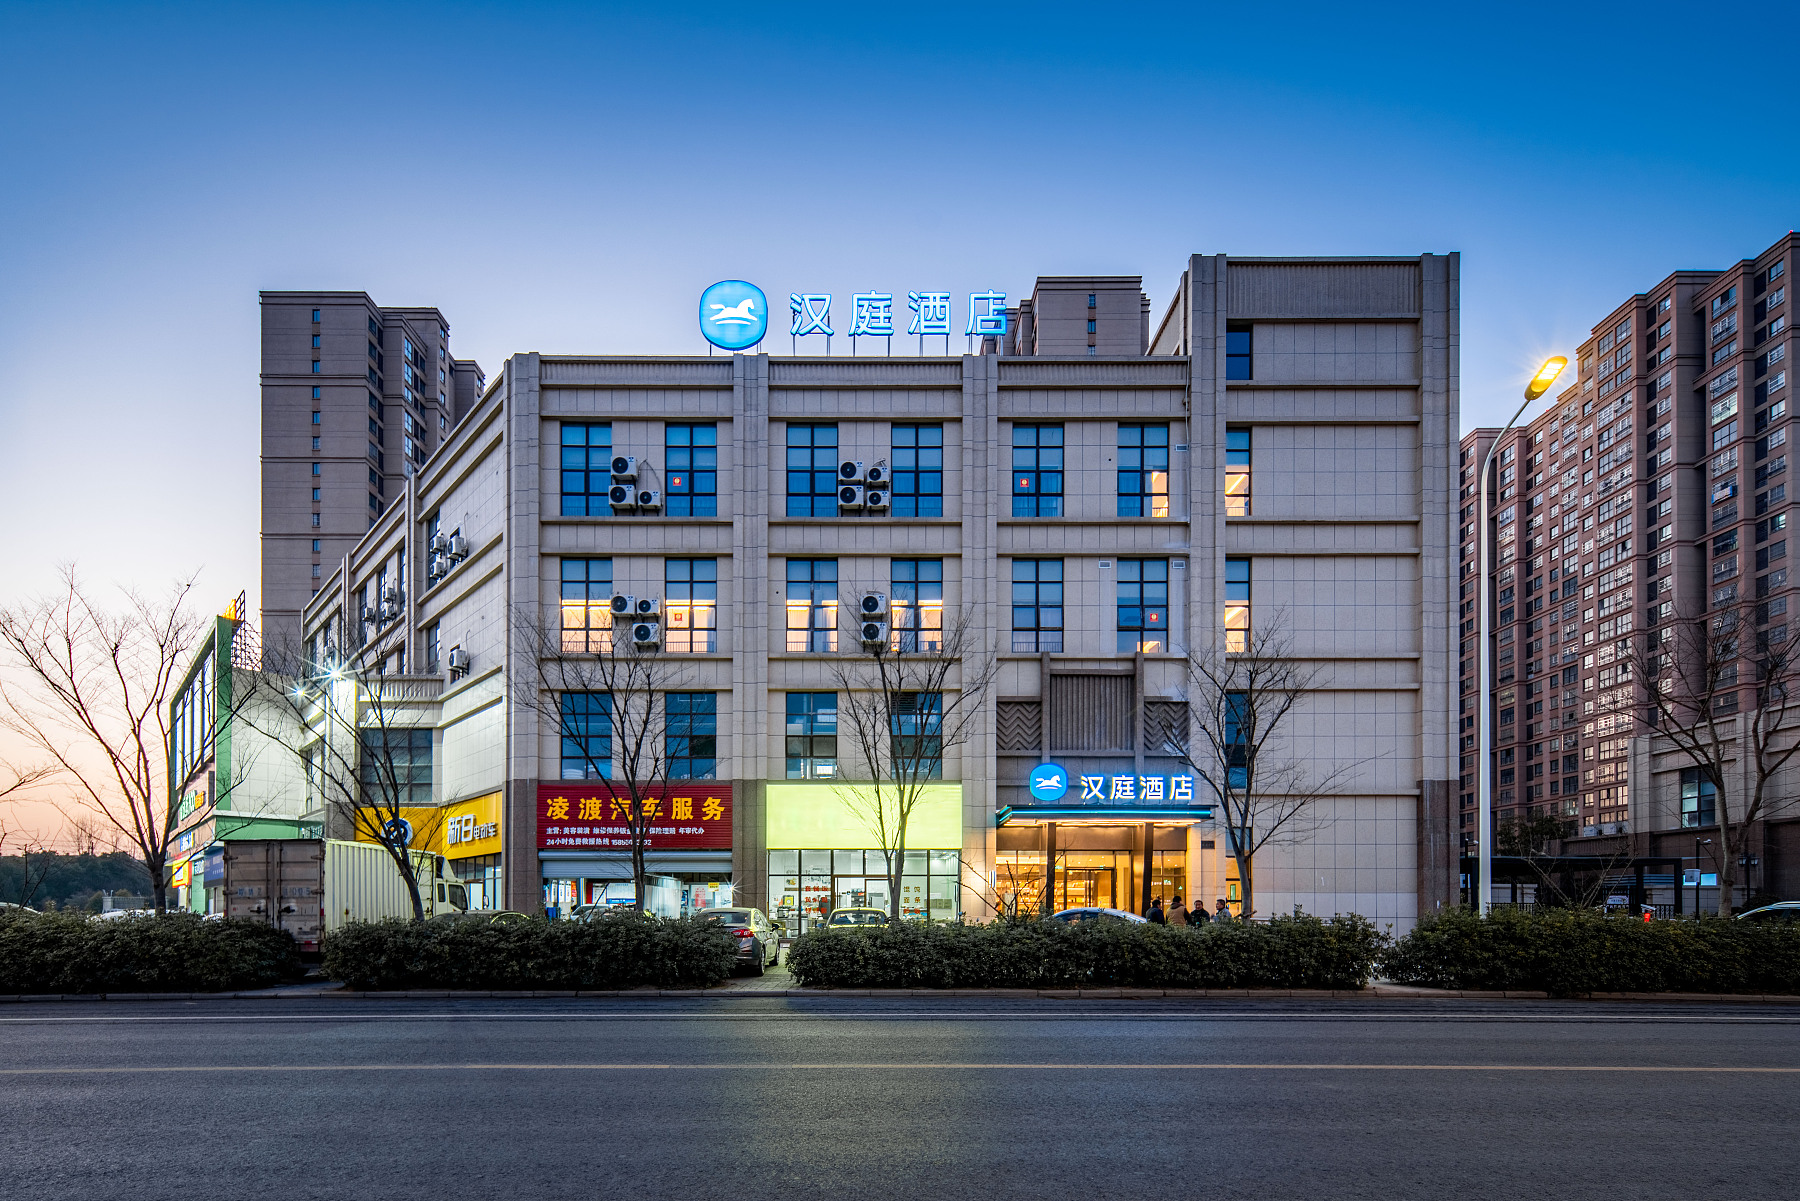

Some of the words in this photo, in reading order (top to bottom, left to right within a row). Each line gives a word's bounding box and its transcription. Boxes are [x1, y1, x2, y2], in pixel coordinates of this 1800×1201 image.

[789, 290, 1008, 336] 汉庭酒店
[1080, 774, 1193, 800] 汉庭酒店
[546, 796, 725, 821] 凌渡汽车服务
